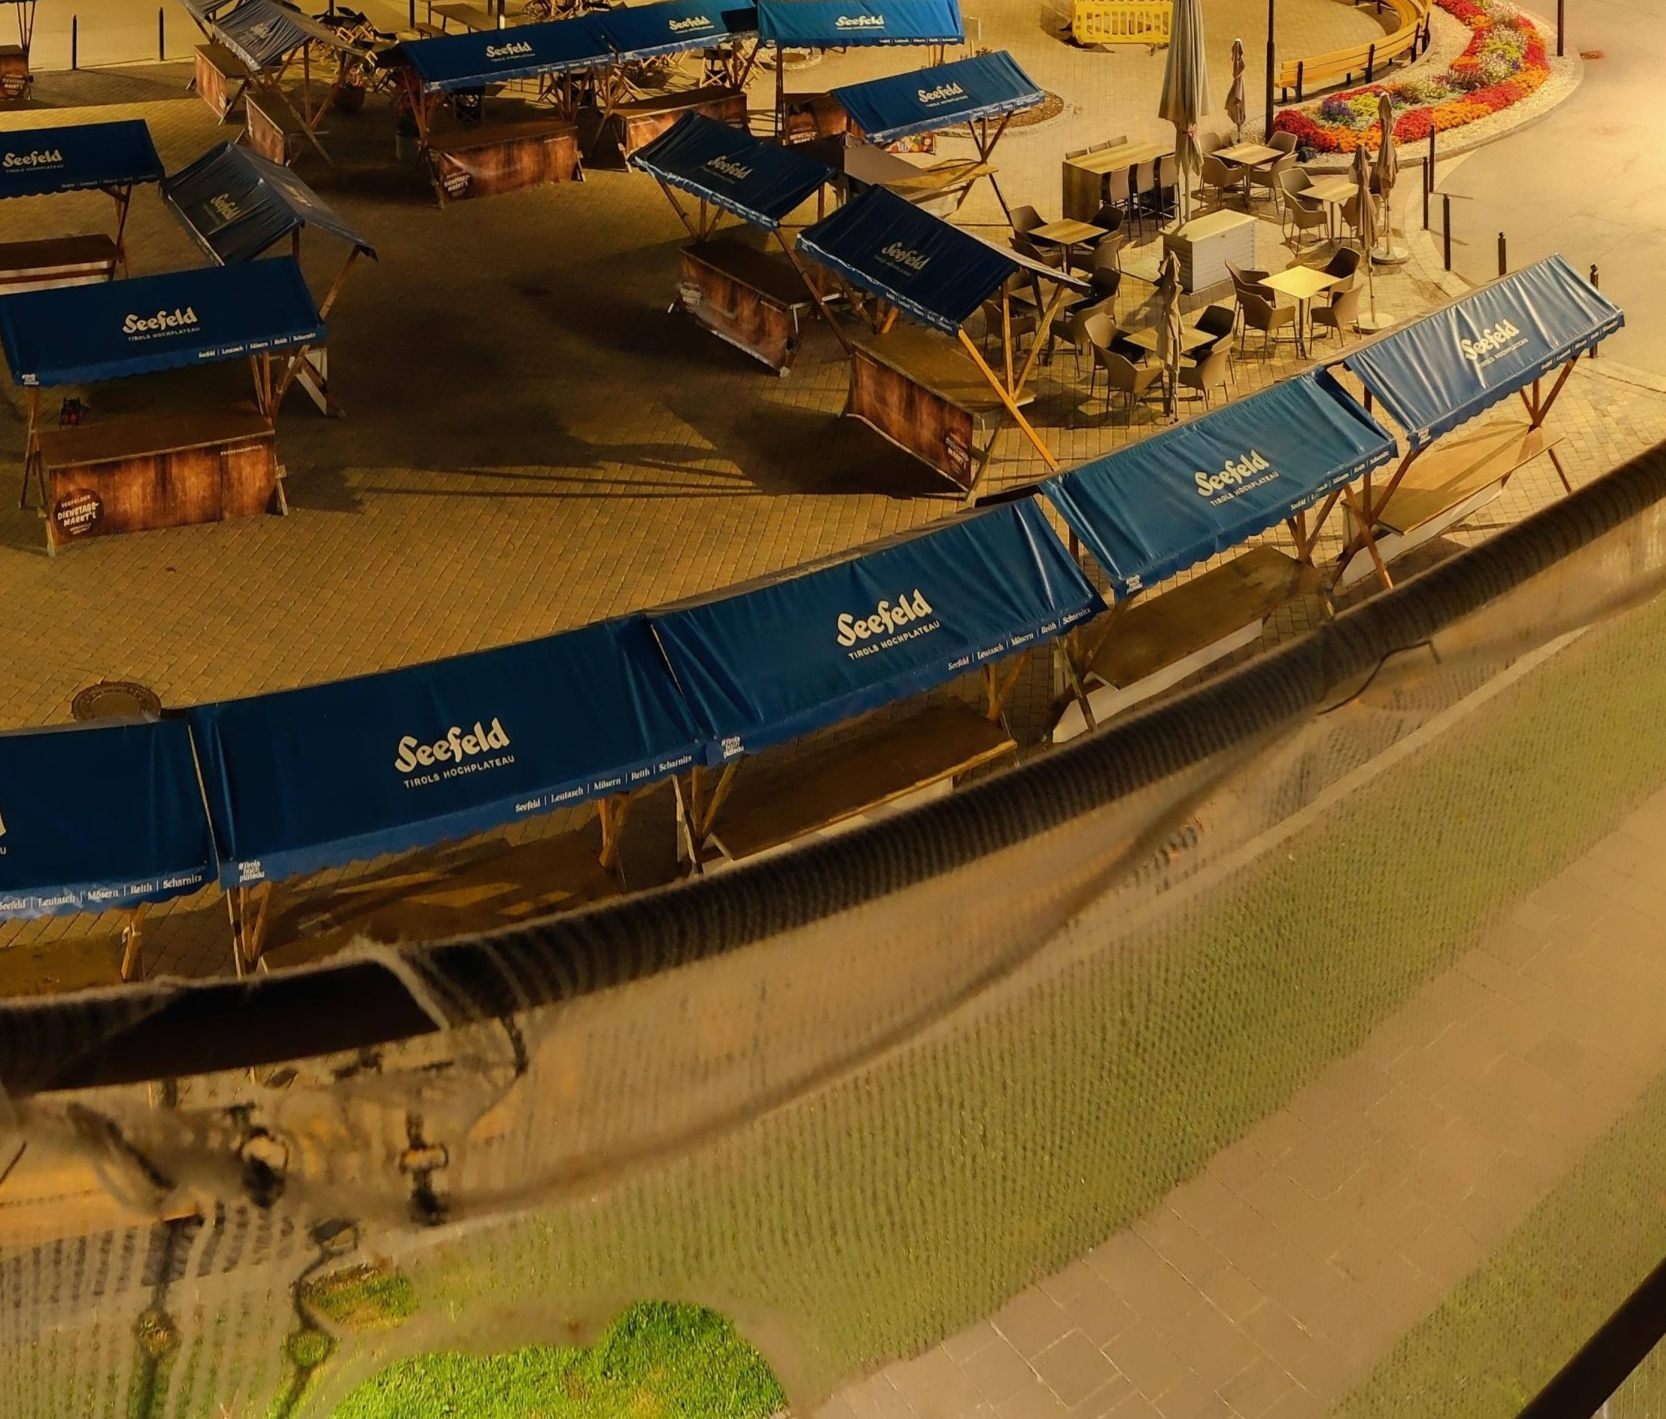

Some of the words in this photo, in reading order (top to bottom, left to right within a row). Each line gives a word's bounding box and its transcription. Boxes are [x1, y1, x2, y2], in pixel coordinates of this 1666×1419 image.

[669, 15, 711, 31] Seefeld
[835, 14, 885, 27] Seefeld
[486, 41, 533, 58] Seefeld
[918, 82, 965, 103] Seefeld
[2, 149, 63, 167] Seefeld
[707, 155, 754, 180] Seefeld
[883, 241, 932, 271] Seefeld
[123, 307, 199, 335] Seefeld
[1460, 318, 1521, 361] Seefeld
[1193, 447, 1271, 497] Seefeld
[1209, 491, 1235, 508] TIROLS
[1233, 470, 1281, 497] HOCHPLATEAU
[836, 588, 933, 648] Seefeld
[848, 644, 880, 662] TIROLS
[880, 620, 942, 649] HOCHPLATEAU
[394, 717, 511, 773] Seefeld
[403, 773, 440, 789] TIROLS
[442, 754, 516, 779] HOCHPLATEAU
[515, 799, 541, 814] Seefeld
[550, 787, 585, 804] Leutasch
[593, 780, 623, 792] Mösern
[629, 766, 651, 782] Reith
[658, 755, 693, 773] Scharnitz
[37, 893, 77, 908] Leutasch
[86, 888, 120, 902] Mösern
[129, 884, 153, 896] Reith
[161, 874, 204, 890] Scharnitz
